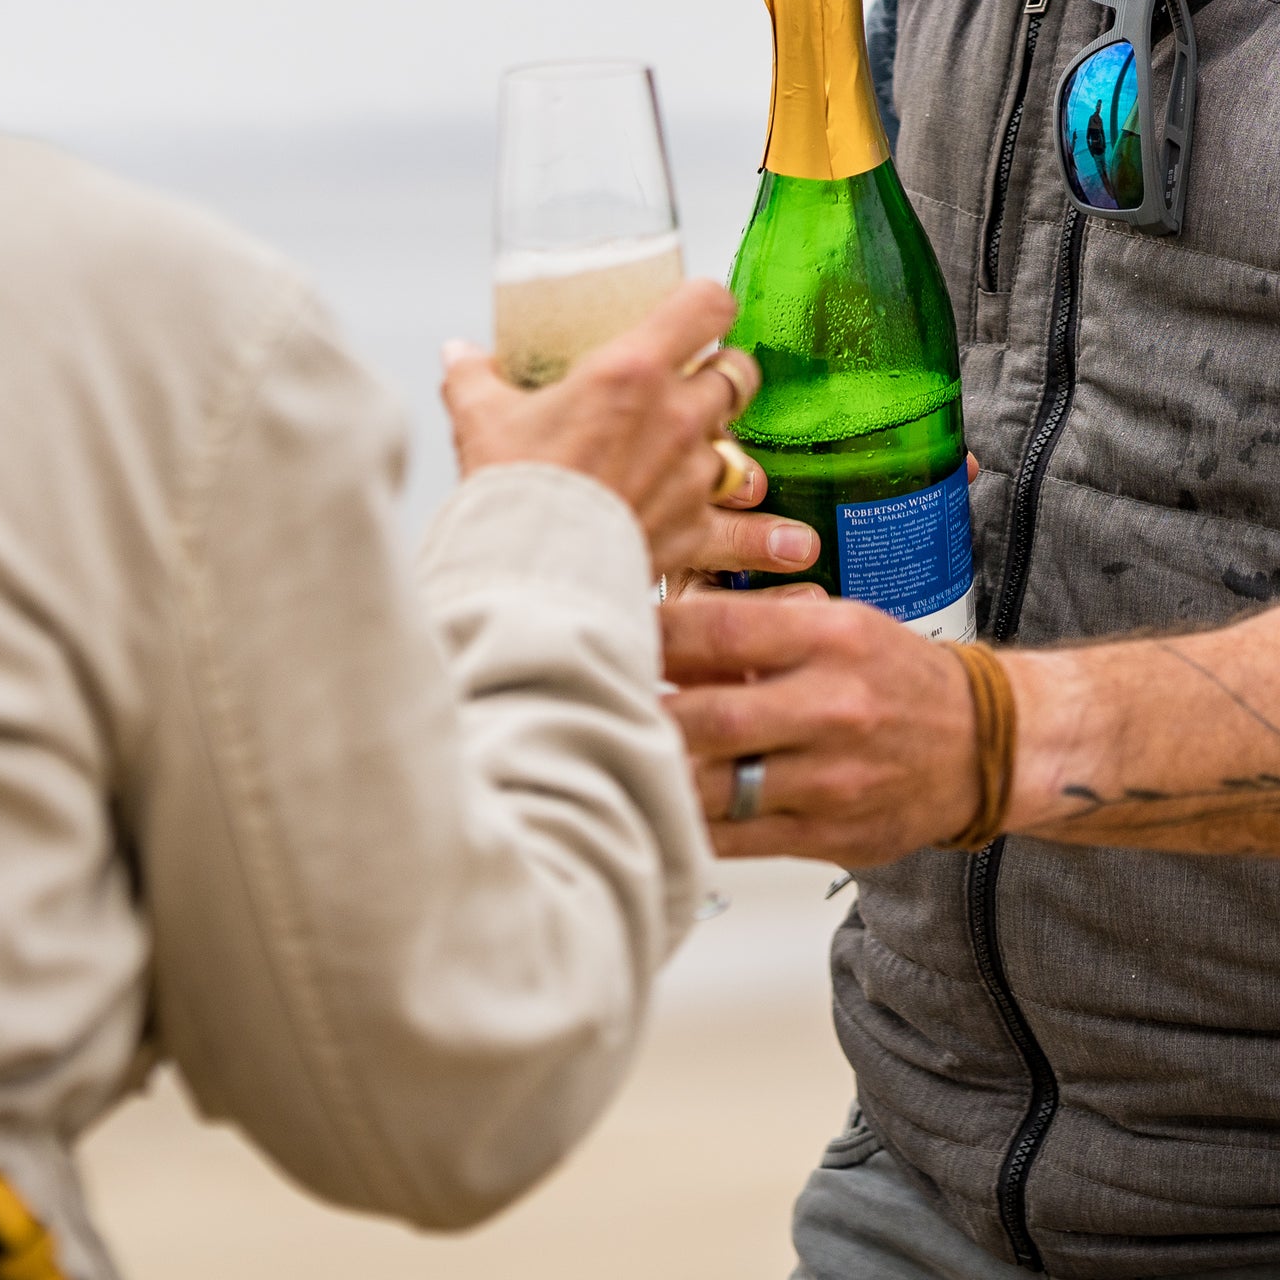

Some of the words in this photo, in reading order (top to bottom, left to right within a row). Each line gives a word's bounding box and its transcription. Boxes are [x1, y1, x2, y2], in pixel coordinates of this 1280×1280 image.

[844, 502, 907, 518] ROBERTSON
[908, 488, 942, 507] WINERY
[878, 509, 919, 523] SPARKLING
[921, 500, 938, 511] WINE
